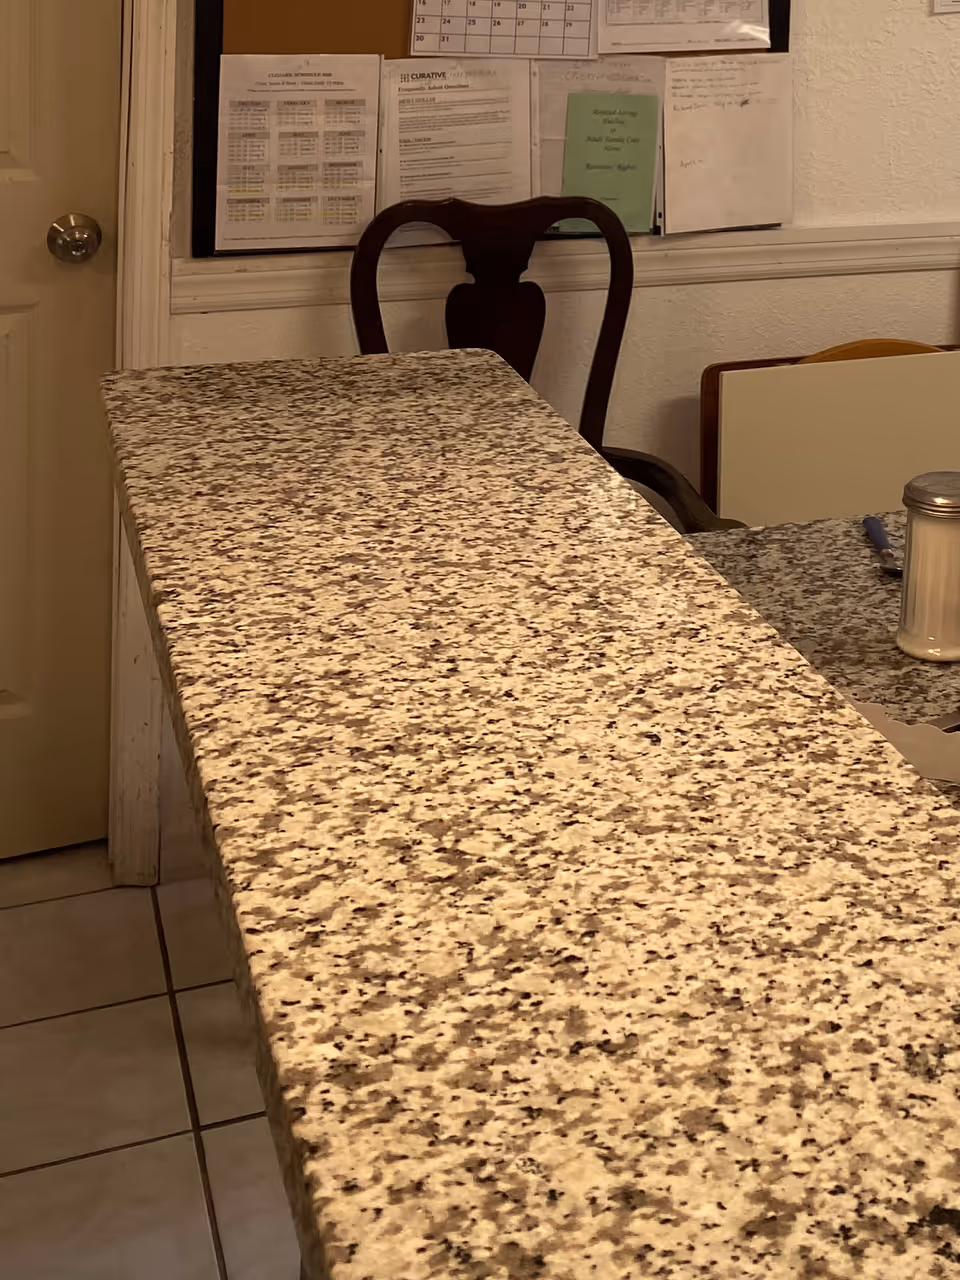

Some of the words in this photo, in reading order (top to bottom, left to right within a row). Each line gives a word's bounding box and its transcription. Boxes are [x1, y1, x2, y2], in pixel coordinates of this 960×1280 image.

[542, 3, 550, 11] 21
[566, 4, 575, 12] 22
[410, 71, 446, 80] CURATIVE
